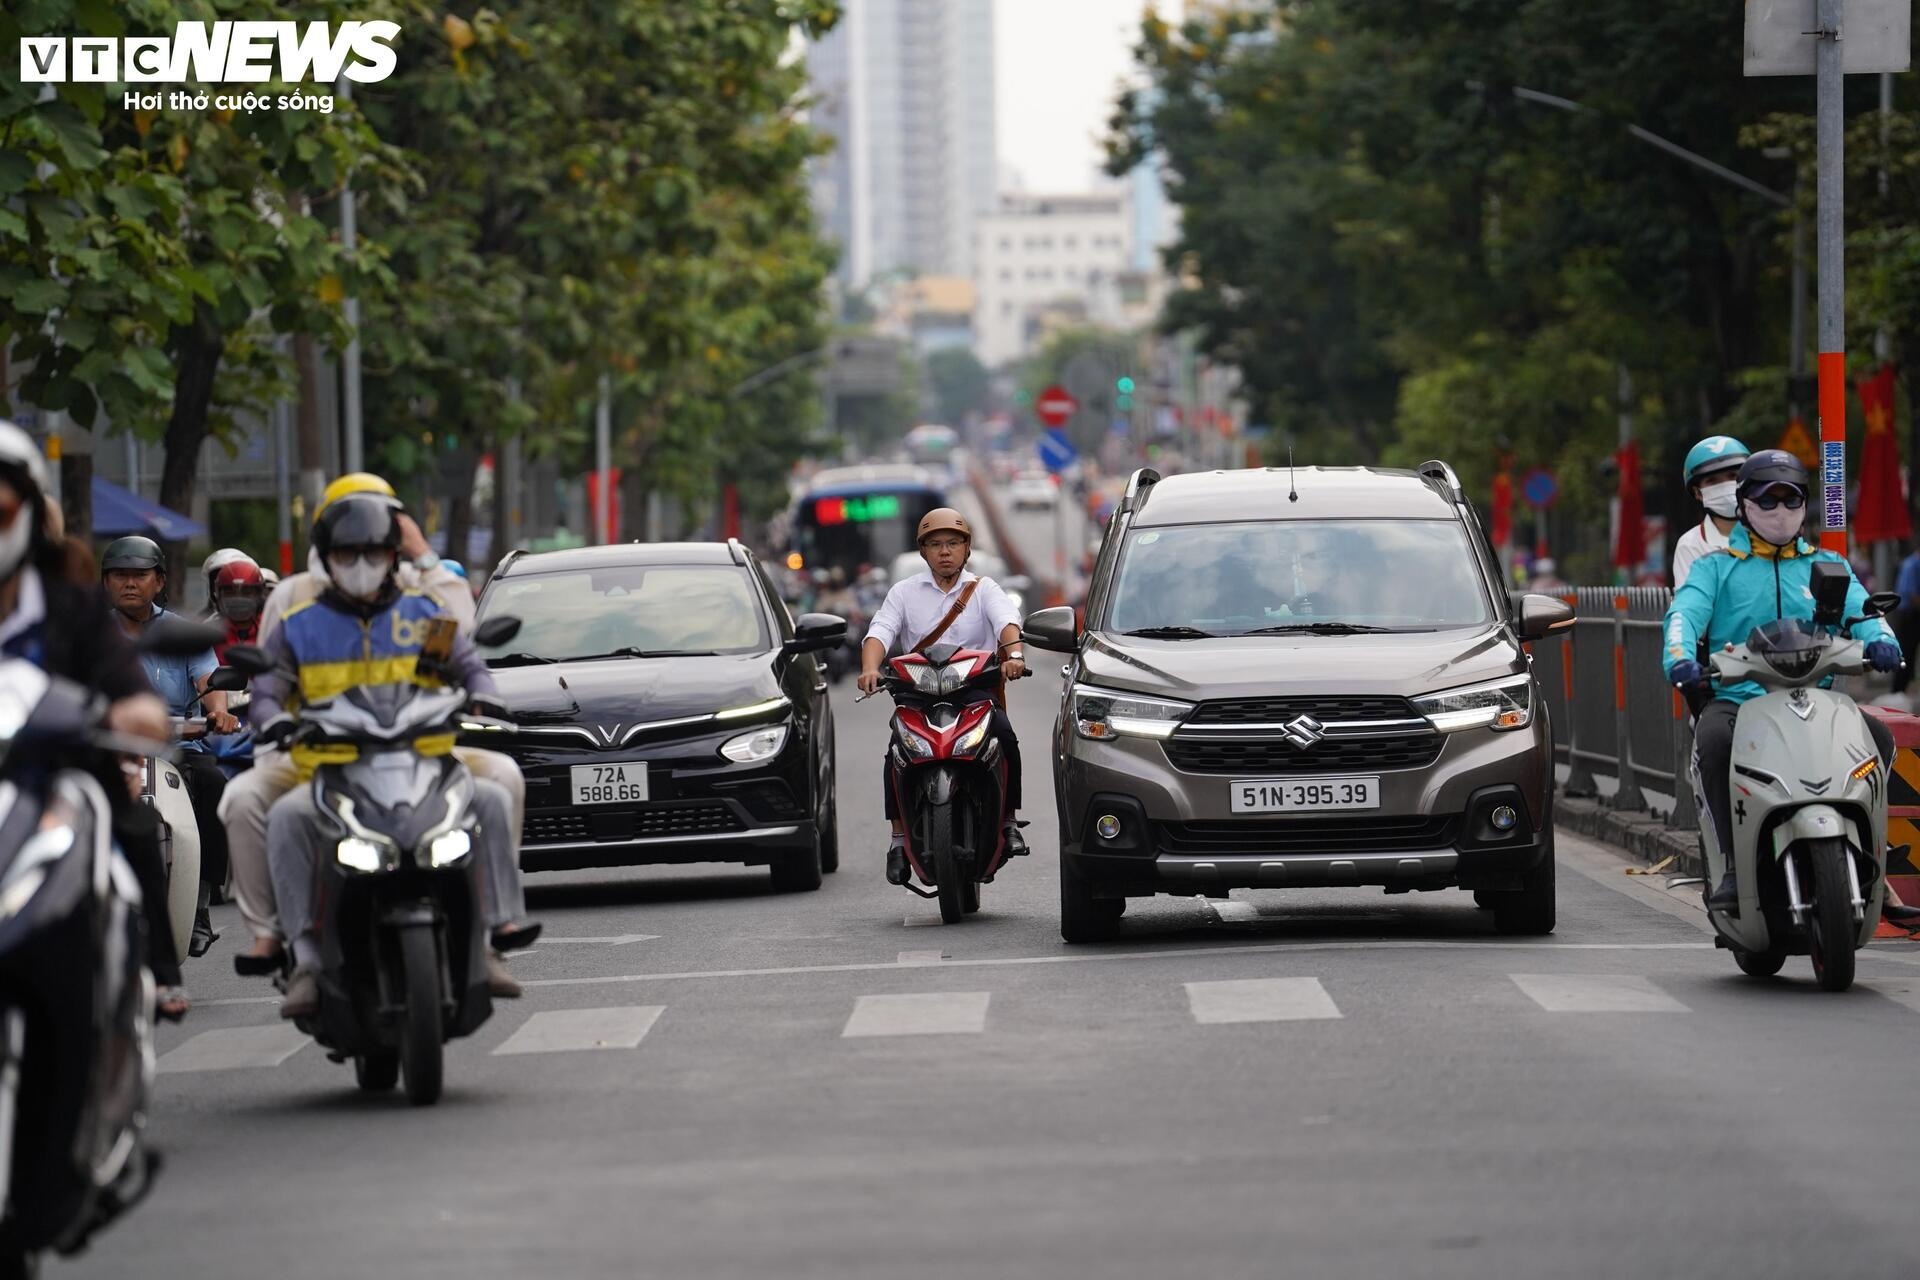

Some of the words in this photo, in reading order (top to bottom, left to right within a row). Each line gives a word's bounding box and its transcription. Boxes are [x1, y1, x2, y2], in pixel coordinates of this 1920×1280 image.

[593, 766, 626, 784] 72A
[580, 784, 641, 802] 588.66
[1243, 784, 1367, 807] 51N-395.39
